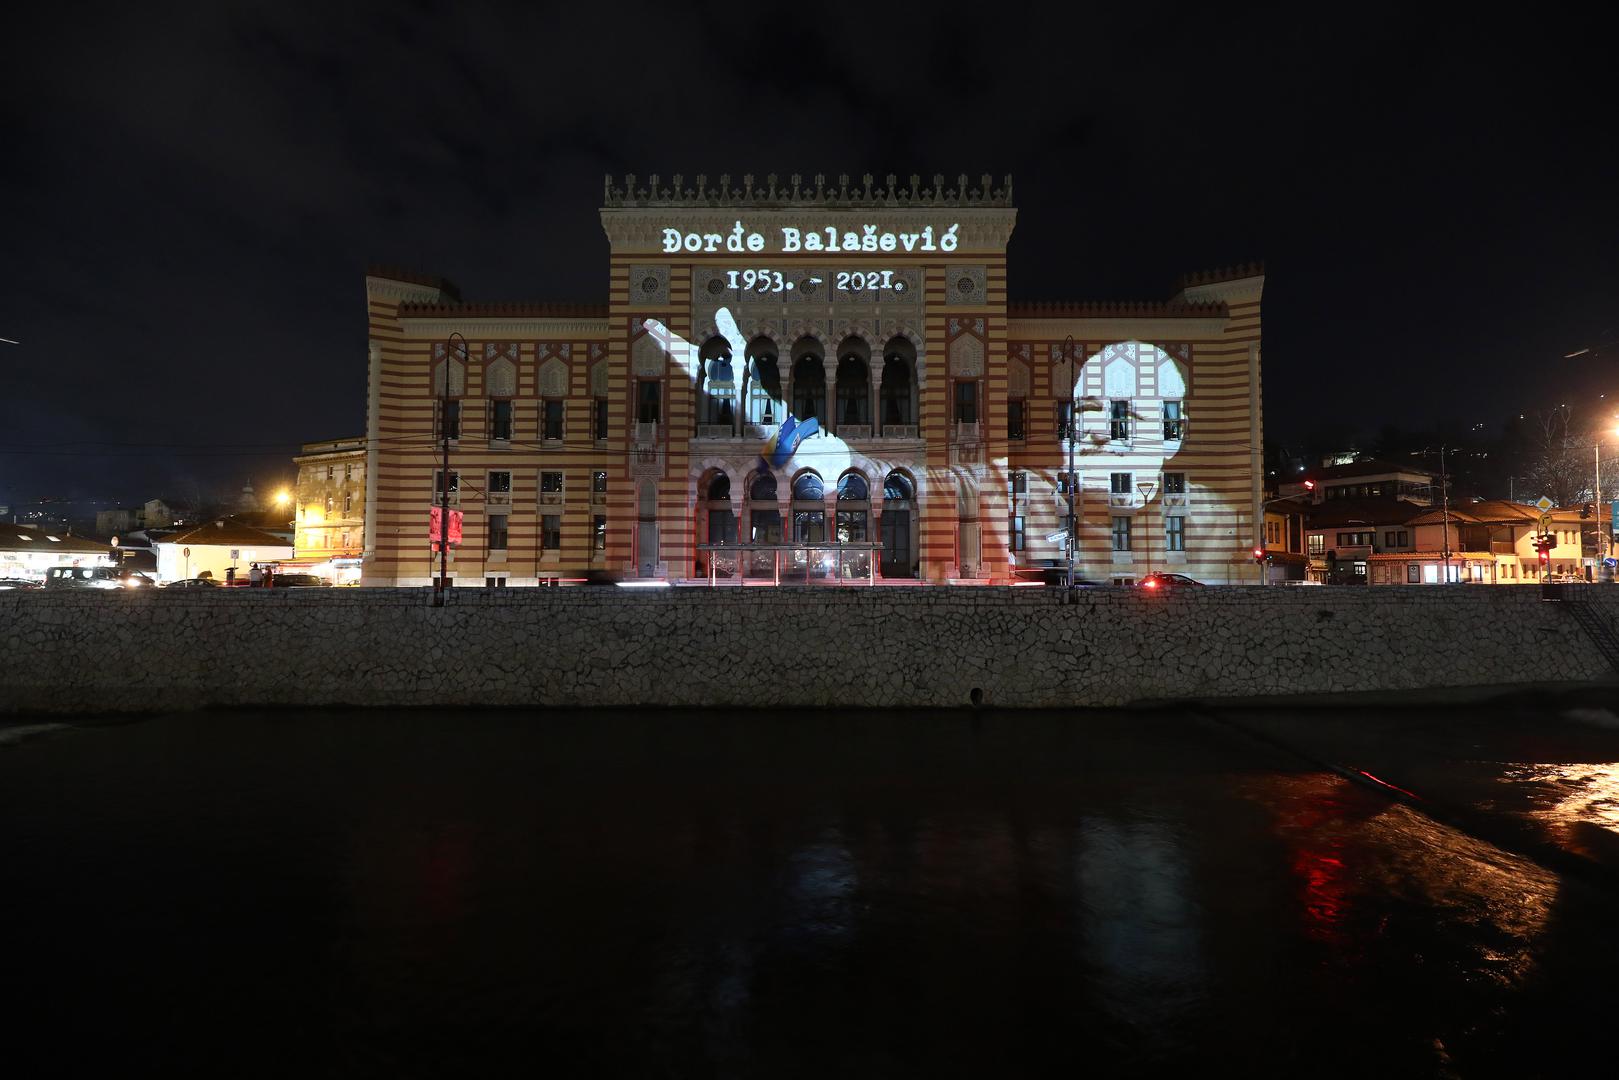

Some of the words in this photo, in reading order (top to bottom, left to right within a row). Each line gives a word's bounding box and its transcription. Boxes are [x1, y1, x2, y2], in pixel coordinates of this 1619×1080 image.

[662, 220, 765, 252] Đorđe
[781, 223, 959, 252] Balašević
[726, 269, 794, 292] 1953.
[836, 270, 903, 291] 2021.
